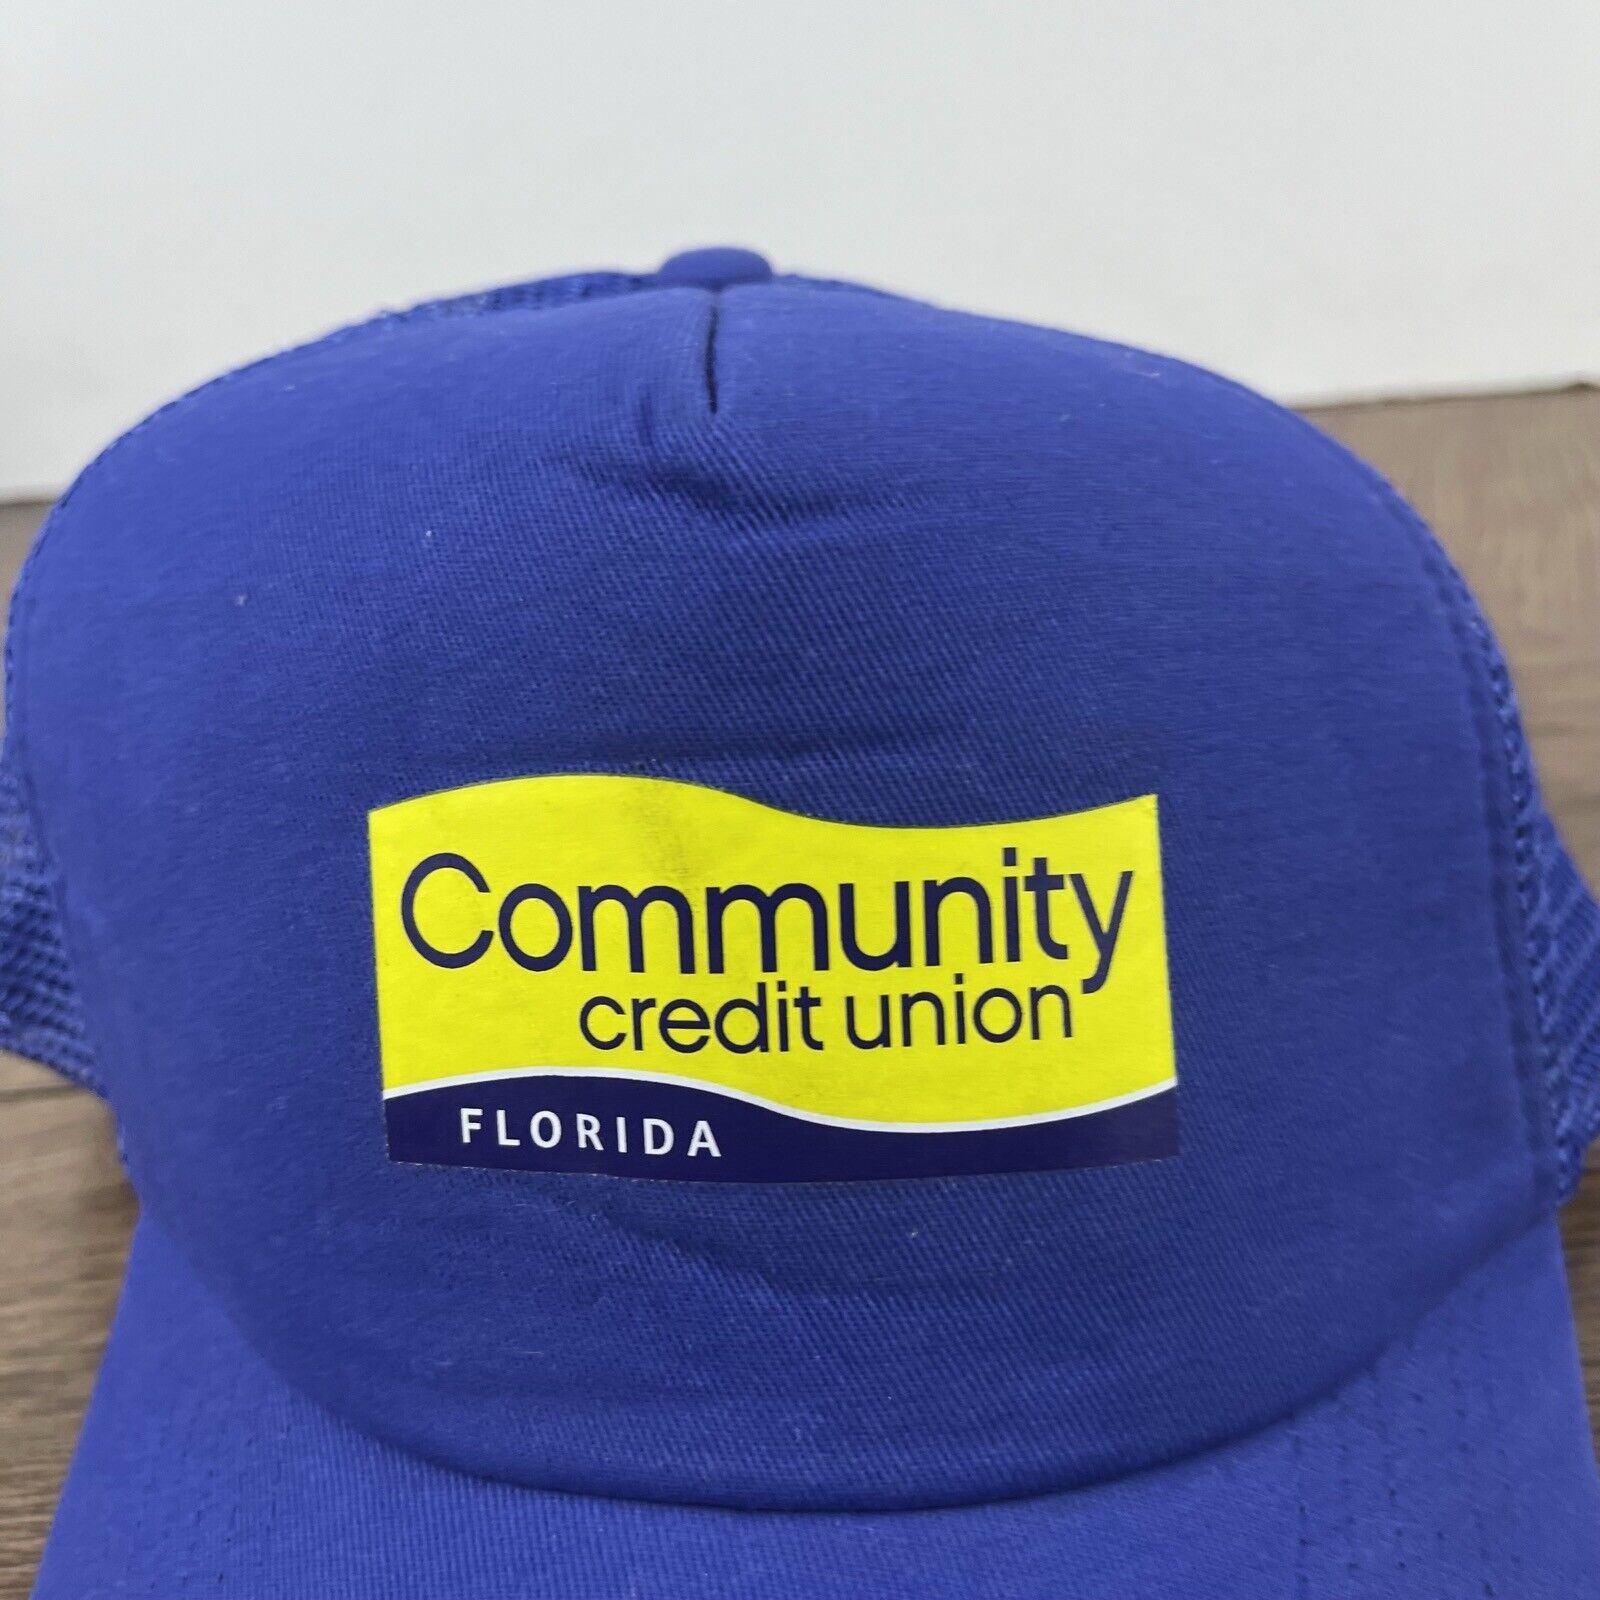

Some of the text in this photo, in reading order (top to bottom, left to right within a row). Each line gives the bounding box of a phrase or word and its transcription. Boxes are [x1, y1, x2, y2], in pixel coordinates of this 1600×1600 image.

[400, 846, 1134, 995] Community
[579, 972, 1073, 1055] credit union
[460, 1107, 722, 1157] FLORIDA
